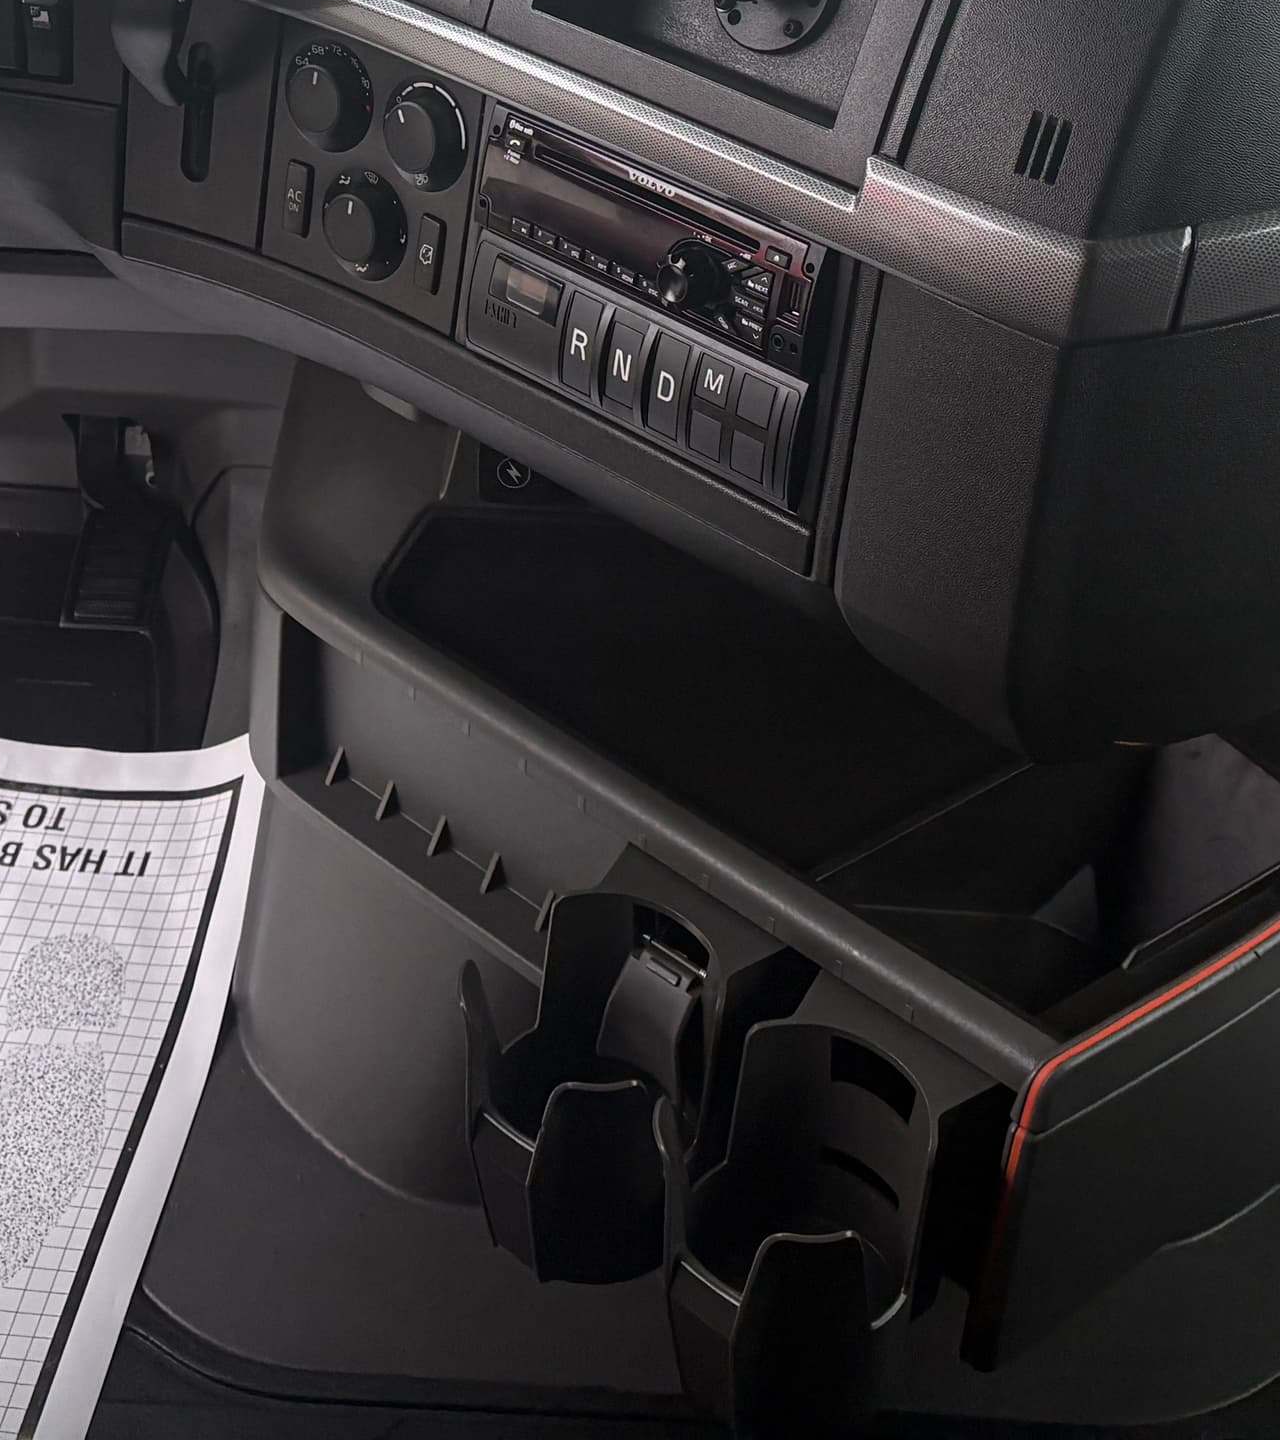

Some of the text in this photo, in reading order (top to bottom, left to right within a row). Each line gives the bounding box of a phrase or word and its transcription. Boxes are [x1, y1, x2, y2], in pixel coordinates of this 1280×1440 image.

[287, 188, 303, 203] AC
[628, 171, 676, 198] VOLVO
[570, 327, 588, 361] R
[612, 349, 632, 382] N
[656, 370, 675, 402] D
[704, 368, 725, 395] M
[23, 804, 66, 831] TO
[32, 843, 108, 876] HAS
[114, 850, 152, 878] IT
